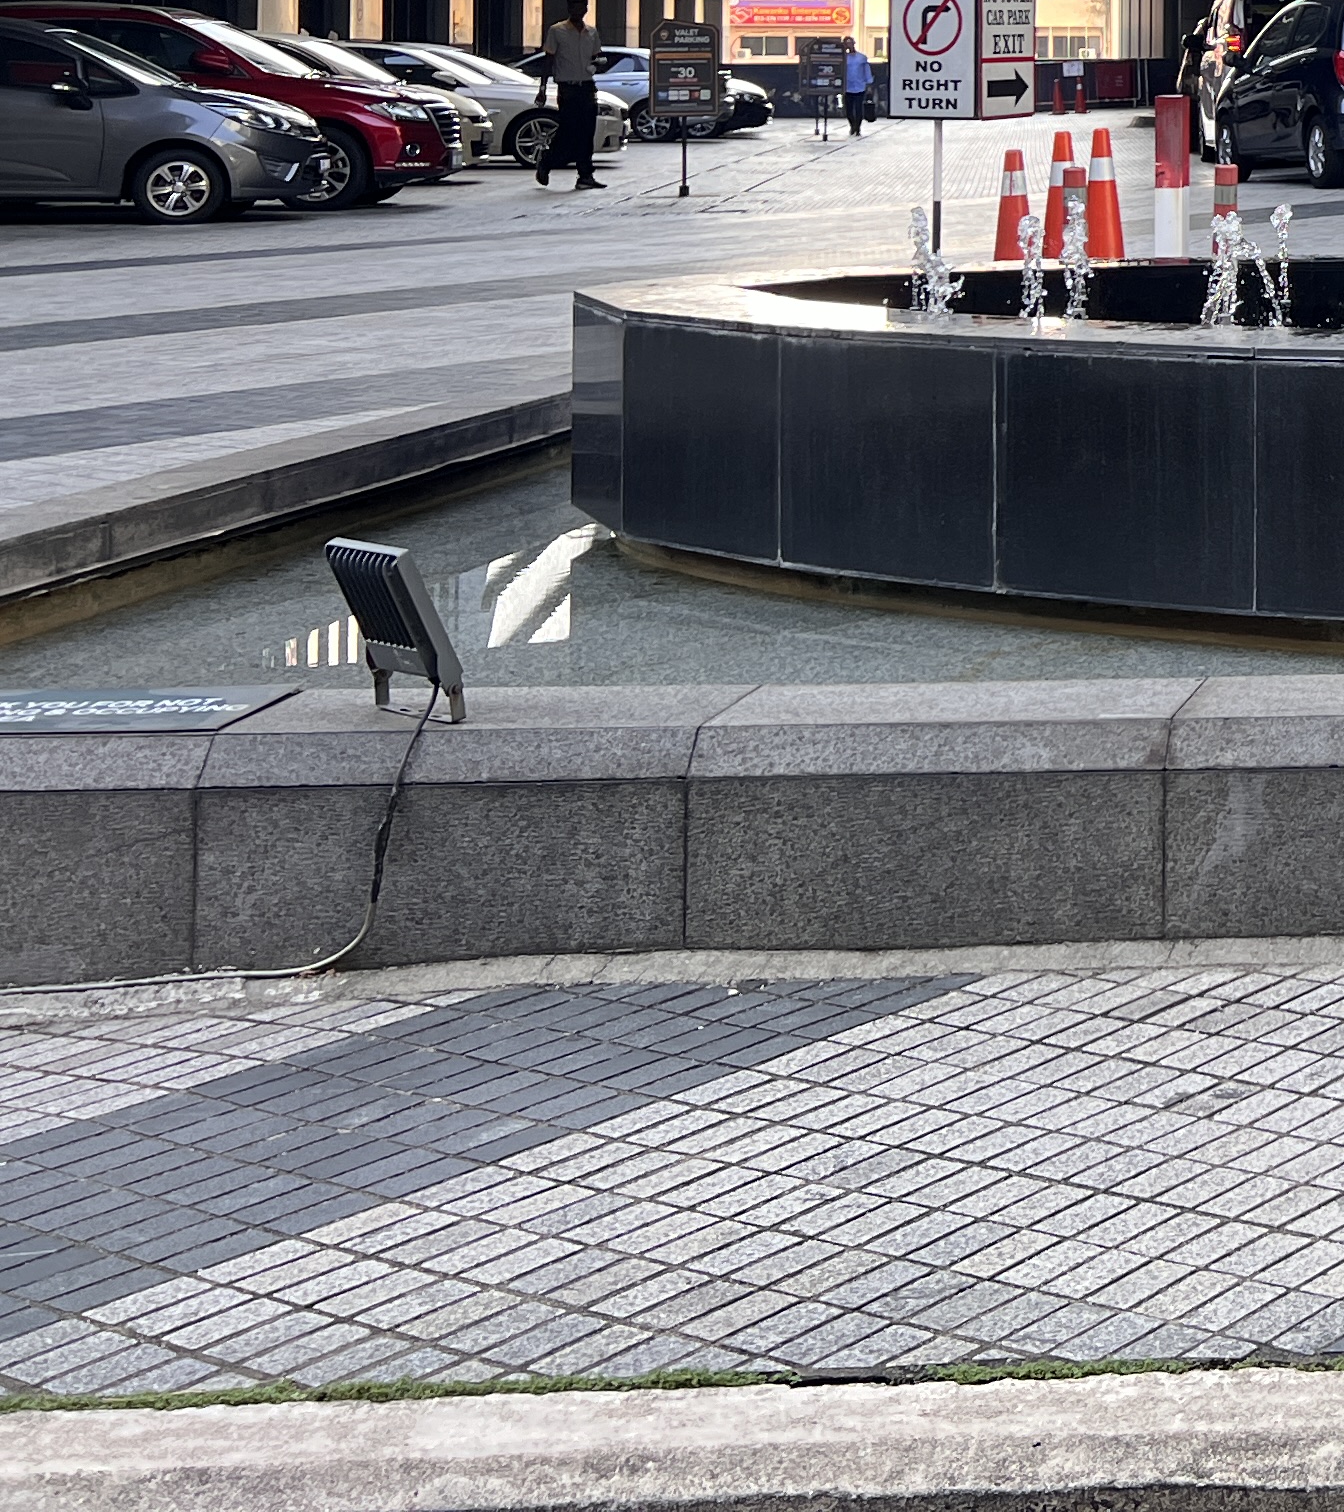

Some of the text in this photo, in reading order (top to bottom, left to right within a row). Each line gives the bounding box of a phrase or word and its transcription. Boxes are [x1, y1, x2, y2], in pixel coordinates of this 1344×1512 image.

[986, 9, 1031, 26] CAR PARK
[674, 28, 699, 36] VALET
[674, 36, 710, 44] PARKING
[992, 33, 1025, 54] EXIT
[677, 66, 695, 78] 30
[915, 60, 943, 73] NO
[902, 79, 962, 91] RIGHT
[904, 97, 958, 110] TURN
[26, 700, 90, 709] YOU
[90, 700, 153, 708] FOR
[154, 697, 224, 707] NOT
[72, 703, 250, 716] OCCUPYING
